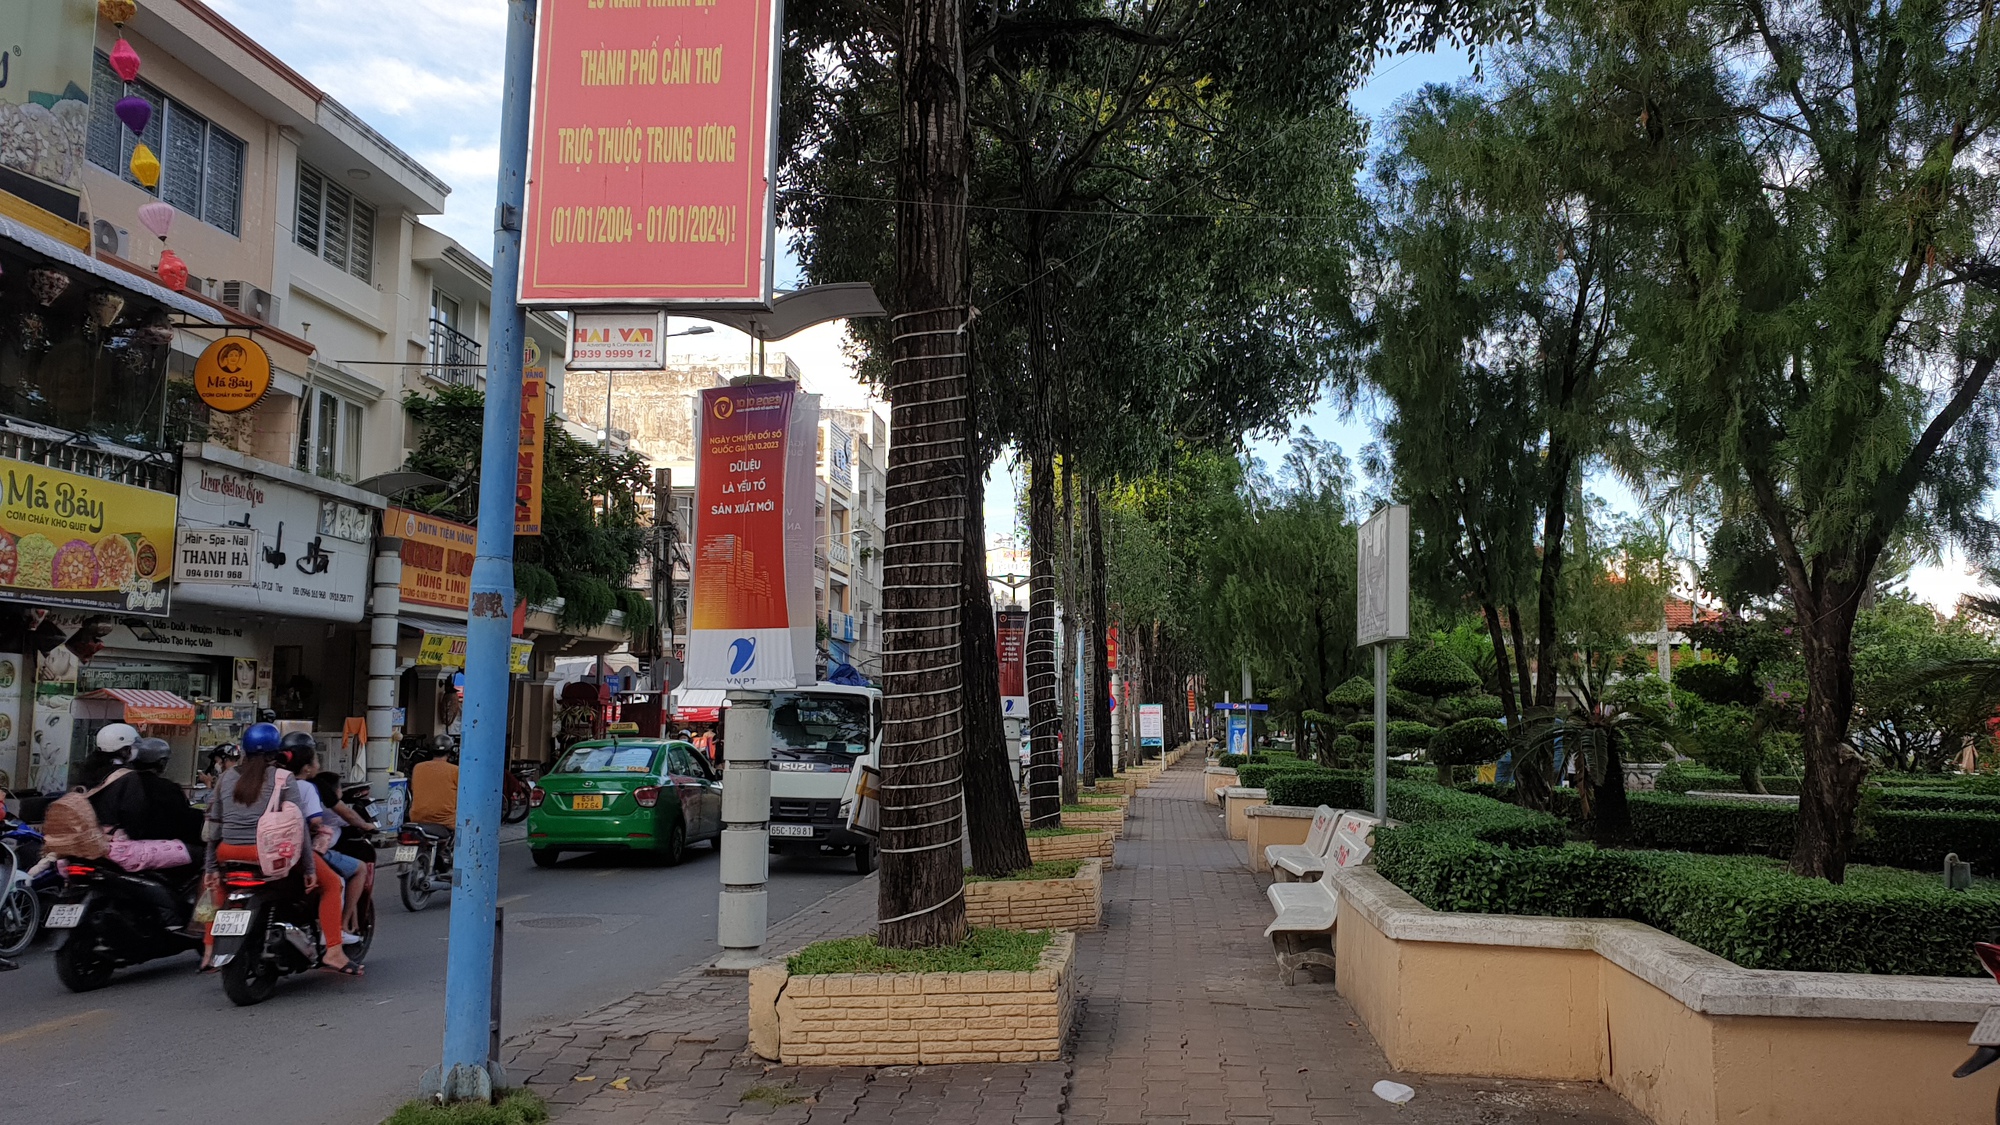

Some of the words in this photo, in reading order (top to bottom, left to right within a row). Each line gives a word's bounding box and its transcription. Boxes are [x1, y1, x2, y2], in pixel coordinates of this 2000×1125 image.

[581, 42, 627, 86] THÀNH
[629, 35, 660, 85] PHỐ
[662, 35, 691, 84] CẦN
[695, 44, 723, 84] THƠ
[558, 124, 593, 172] TRỰC
[598, 119, 642, 172] THUỘC
[647, 126, 693, 163] TRUNG
[697, 122, 736, 163] ƯƠNG
[550, 206, 632, 247] (01/01/2004
[646, 205, 736, 246] 01/01/2024)!
[574, 328, 610, 342] HAI
[574, 349, 601, 358] 0939
[605, 349, 633, 358] 9999
[638, 349, 651, 358] 12
[207, 376, 226, 388] Má
[228, 376, 253, 392] Bảy
[710, 436, 730, 444] NGÀY
[731, 431, 757, 443] CHUYỂN
[758, 431, 771, 439] ĐỔI
[772, 429, 782, 438] SỐ
[711, 445, 734, 454] QUỐC
[748, 442, 779, 450] 10.10.2023
[722, 481, 735, 494] LÀ
[737, 478, 752, 492] YẾU
[753, 476, 766, 491] TỐ
[8, 469, 49, 509] Má
[54, 482, 104, 534] Bảy
[711, 502, 732, 515] SẢN
[734, 500, 755, 514] XUẤT
[756, 498, 774, 512] MỚI
[6, 509, 26, 522] CƠM
[27, 513, 50, 526] CHÁY
[51, 516, 67, 529] KHO
[417, 521, 438, 537] DNTN
[439, 526, 456, 542] TIỆM
[457, 530, 474, 545] VÀNG
[522, 524, 538, 532] LINH
[185, 533, 202, 544] Hair
[210, 535, 226, 547] Spa
[233, 536, 249, 546] Nail
[182, 549, 227, 565] THANH
[231, 547, 249, 566] HÀ
[186, 568, 202, 577] 094
[203, 568, 224, 578] 6161
[226, 569, 243, 579] 968
[416, 572, 442, 590] HÙNG
[445, 580, 466, 594] LINH
[171, 637, 183, 647] Tạo
[184, 638, 198, 648] Học
[199, 640, 213, 648] Viên
[726, 677, 757, 685] VNPT
[779, 762, 814, 771] ISUZU
